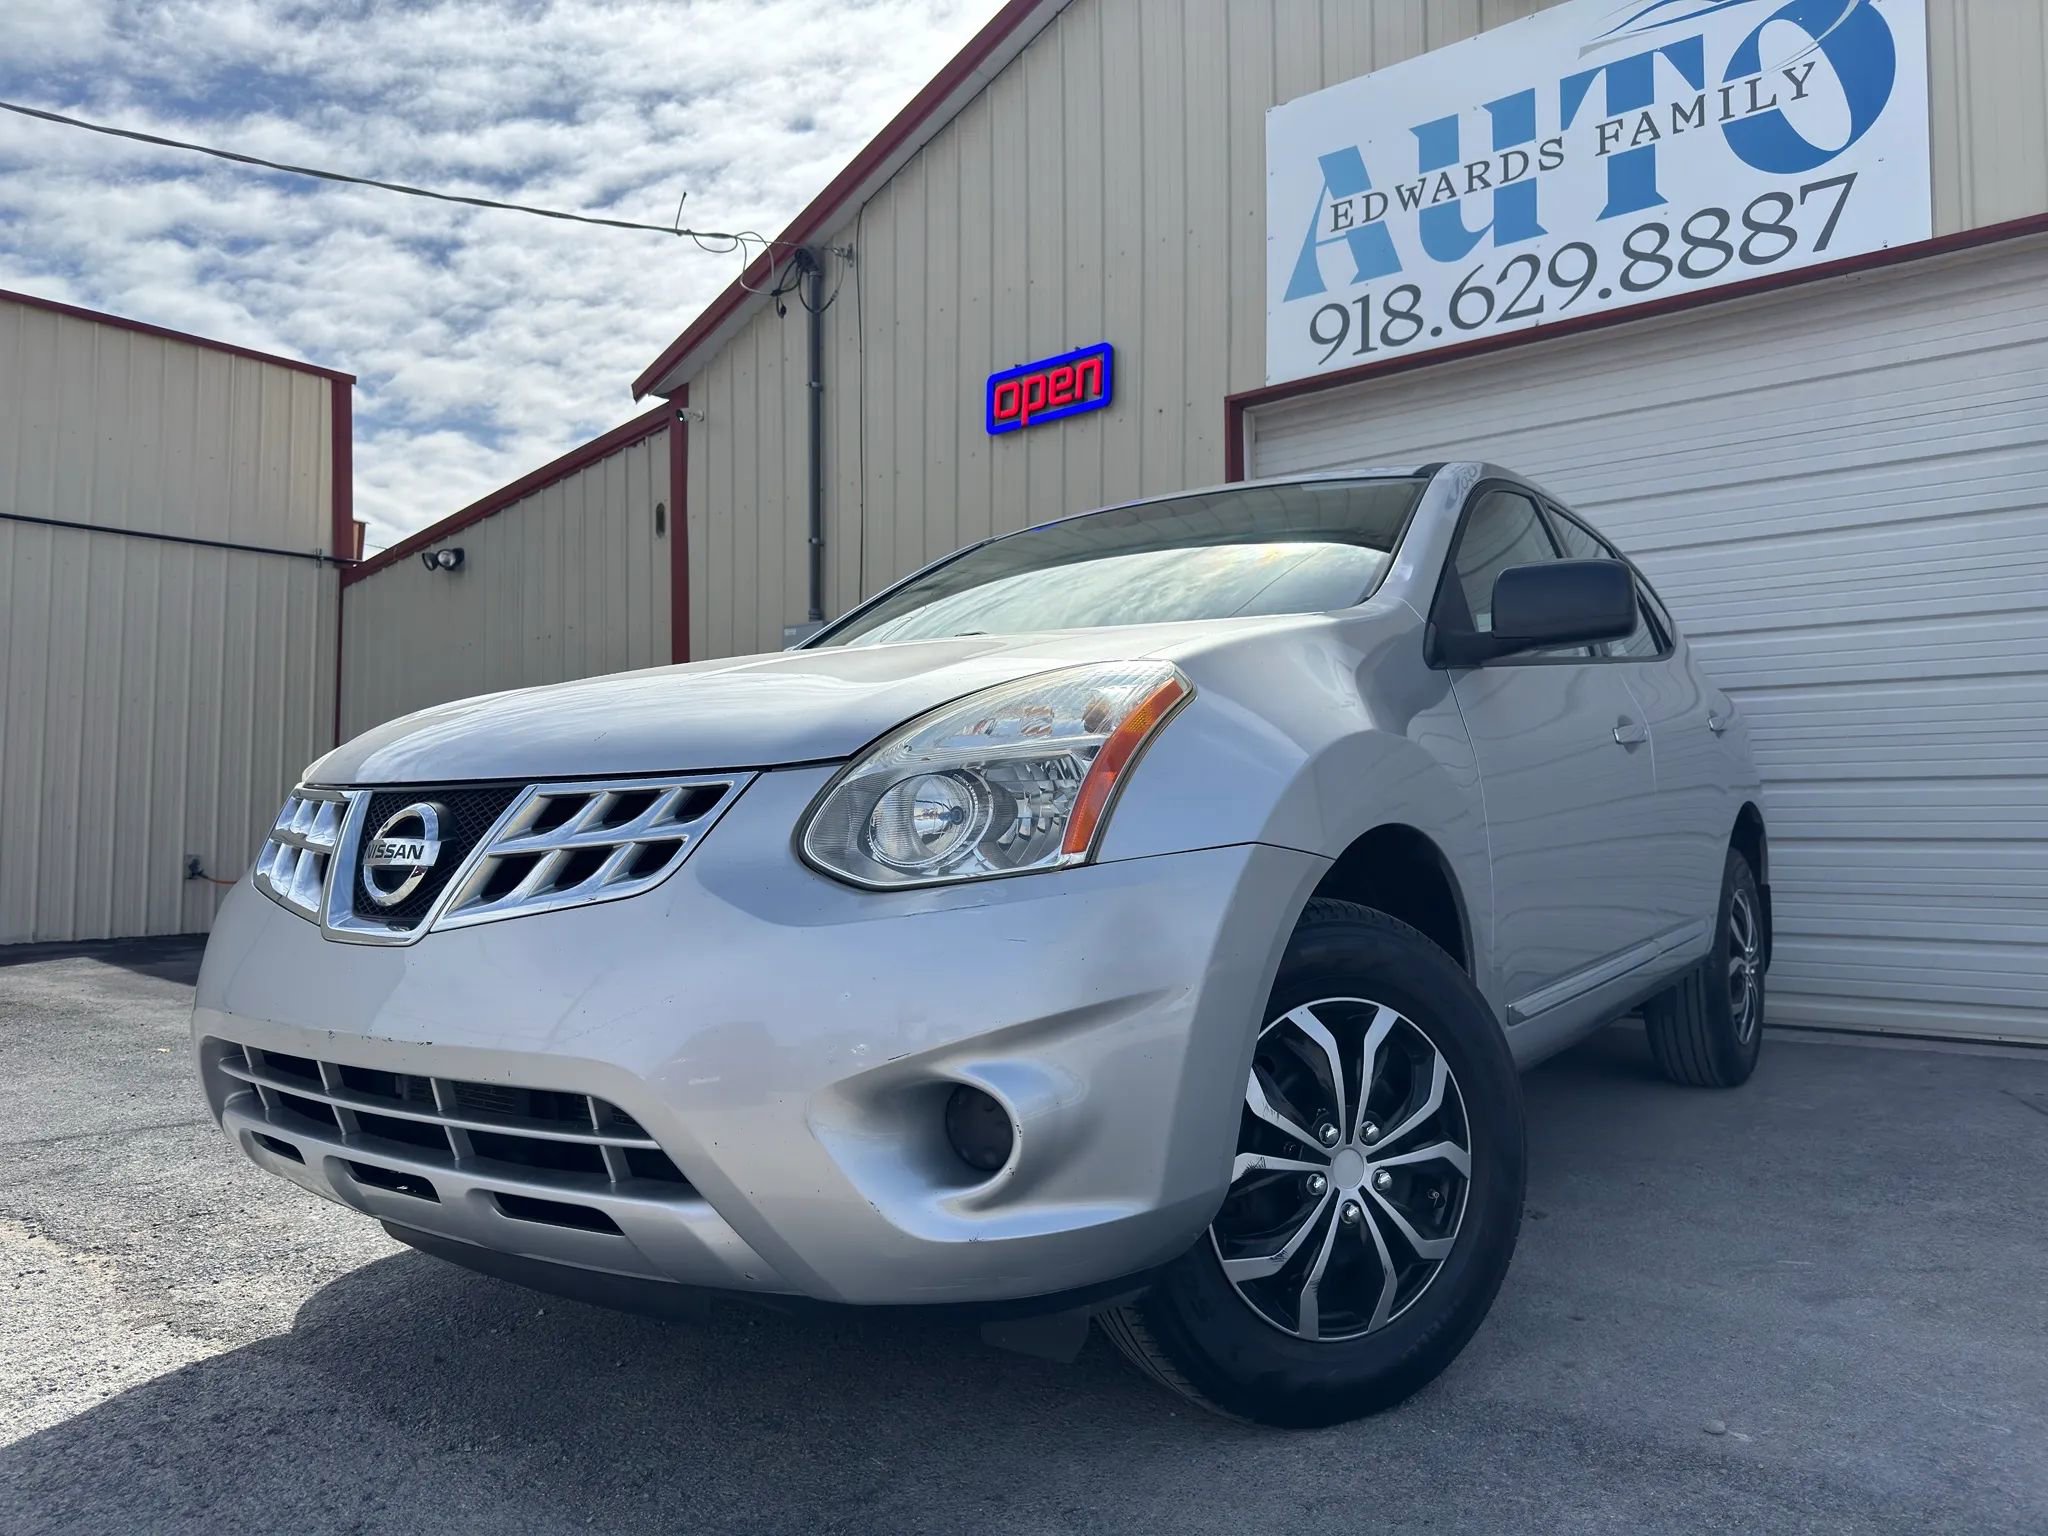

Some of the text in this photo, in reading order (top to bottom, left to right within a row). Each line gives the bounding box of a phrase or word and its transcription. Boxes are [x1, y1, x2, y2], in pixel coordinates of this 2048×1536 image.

[1329, 60, 1817, 233] EDWARDS FAMILY
[1307, 171, 1860, 366] 918.629.8887
[993, 357, 1103, 427] open
[364, 843, 426, 860] NISSAN
